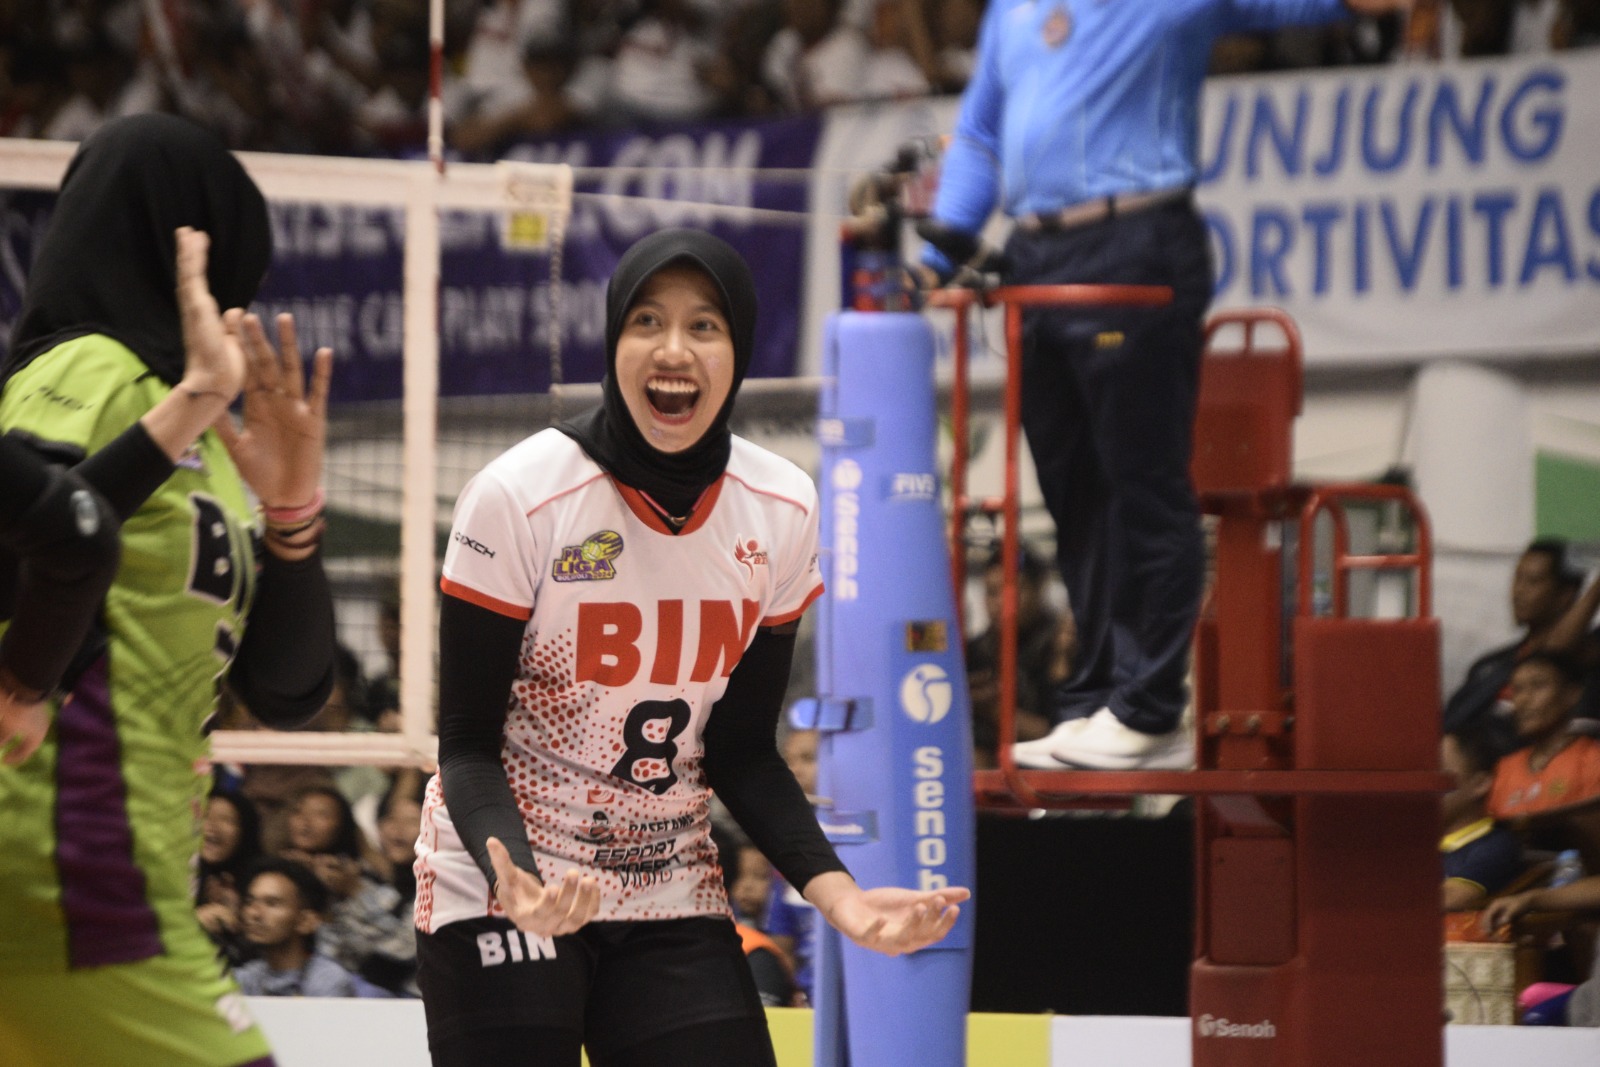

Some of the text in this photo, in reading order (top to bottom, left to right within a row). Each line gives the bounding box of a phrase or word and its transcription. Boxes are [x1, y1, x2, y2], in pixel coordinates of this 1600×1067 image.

[556, 560, 611, 575] LIGA
[575, 598, 760, 687] BIN
[610, 698, 691, 795] 8
[593, 838, 677, 862] ESPORT
[476, 929, 558, 968] BIN
[1215, 1017, 1277, 1038] Senoh
